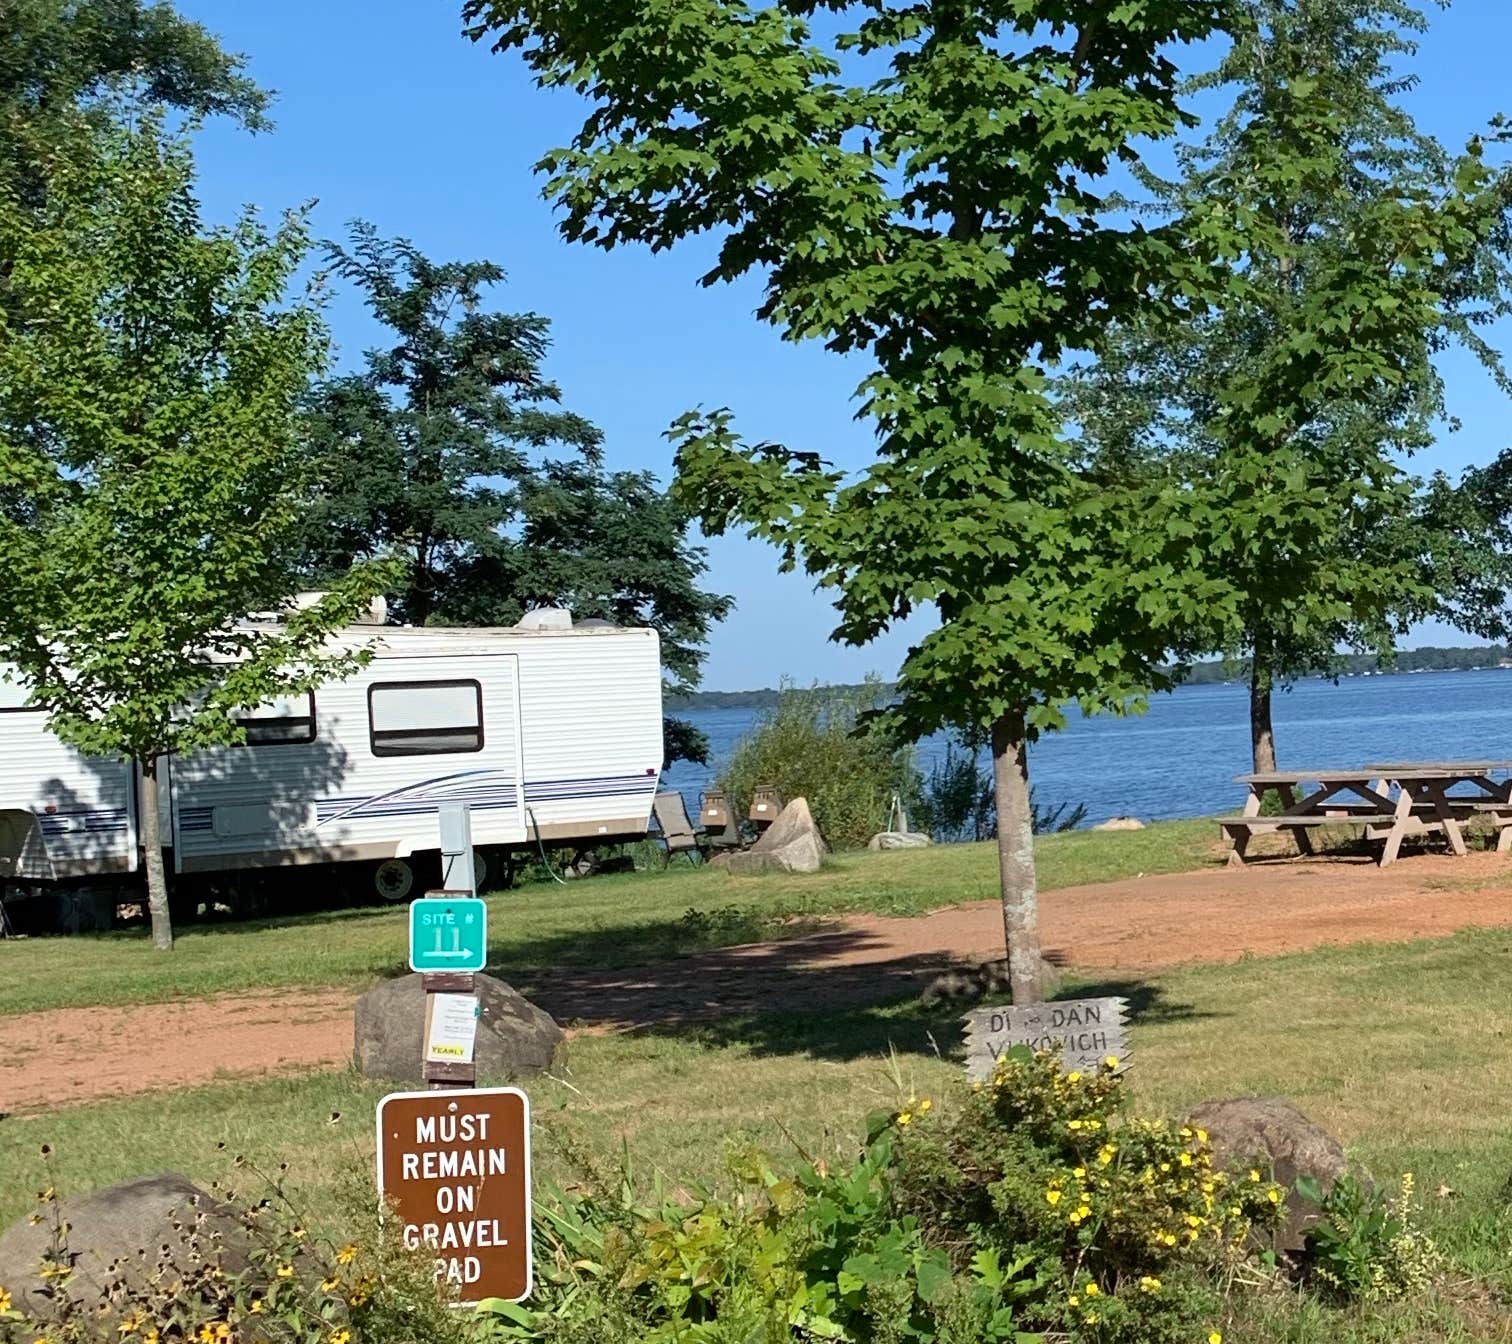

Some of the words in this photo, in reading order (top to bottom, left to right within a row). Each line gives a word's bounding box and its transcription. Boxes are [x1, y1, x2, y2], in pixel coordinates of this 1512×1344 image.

[422, 913, 456, 926] SITE
[464, 913, 475, 925] #
[432, 927, 460, 952] 11
[1052, 1006, 1101, 1028] DAN
[416, 1113, 491, 1144] MUST
[402, 1148, 506, 1180] REMAIN
[436, 1185, 474, 1214] ON
[403, 1219, 508, 1252] GRAVEL
[433, 1256, 481, 1285] PAD
